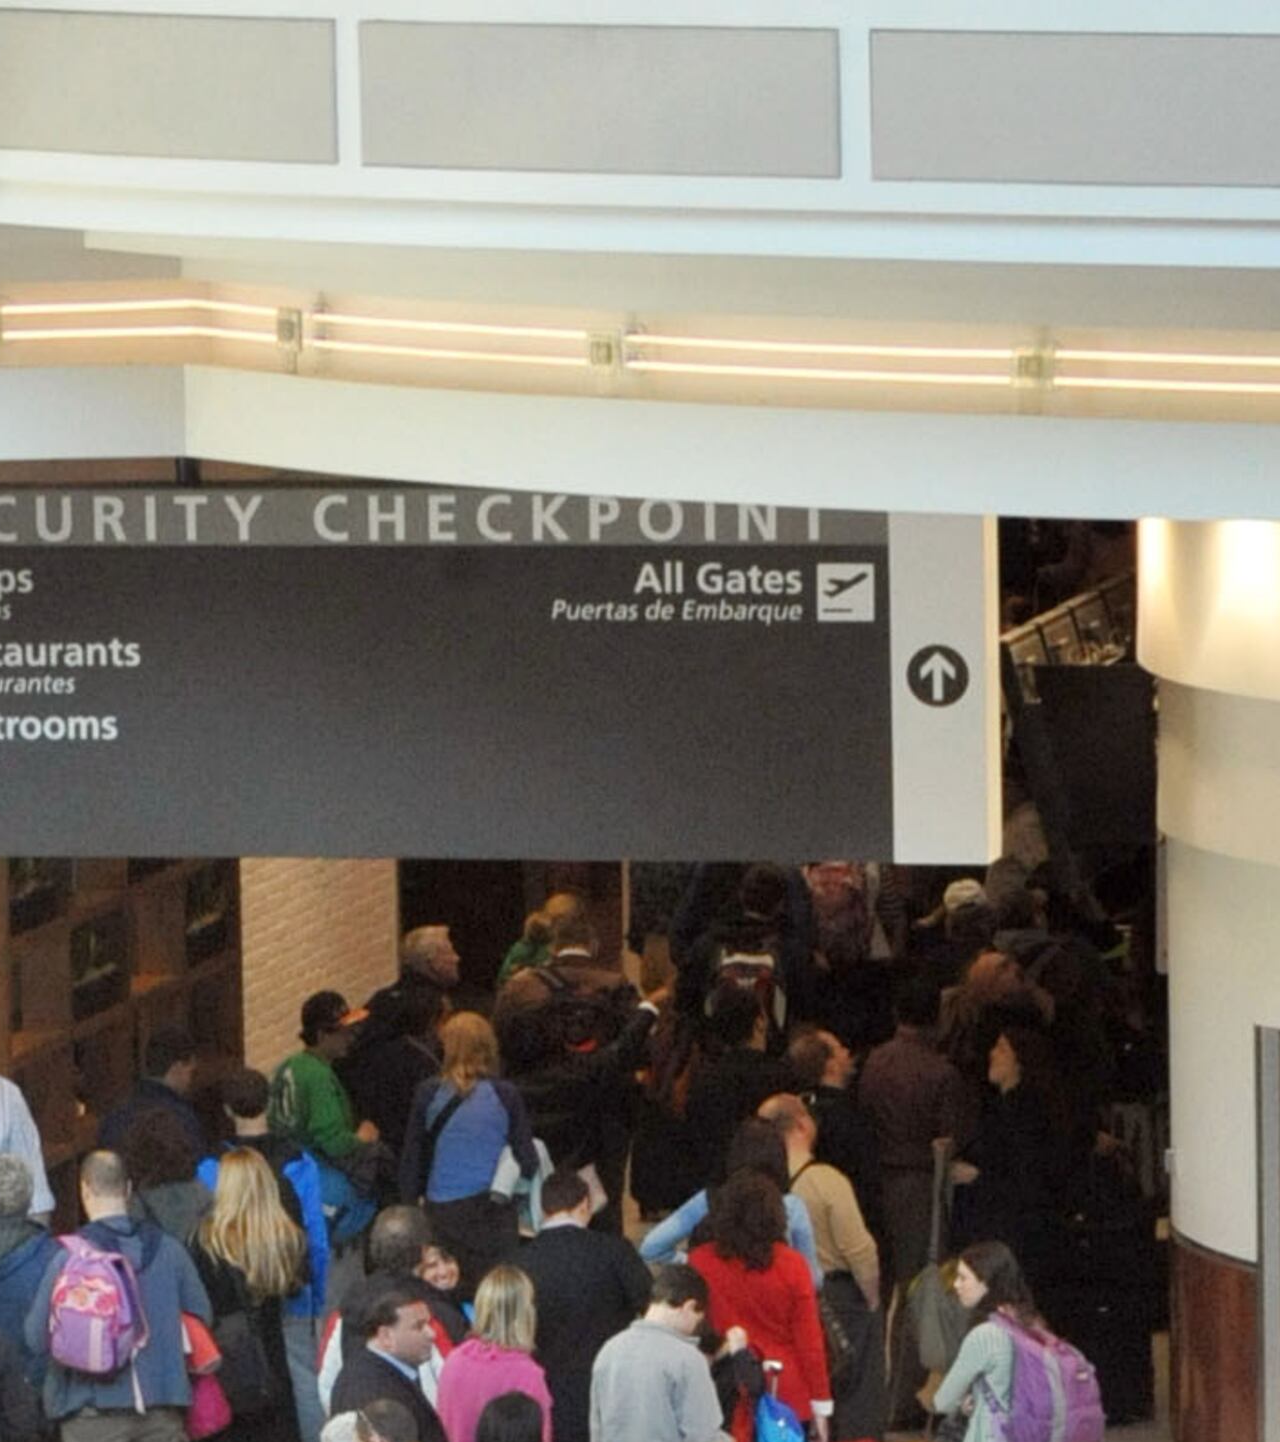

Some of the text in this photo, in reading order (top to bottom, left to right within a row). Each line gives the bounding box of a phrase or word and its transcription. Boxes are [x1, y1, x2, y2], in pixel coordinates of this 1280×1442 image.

[634, 562, 803, 596] All Gates
[551, 599, 803, 627] Puertas de Embarque
